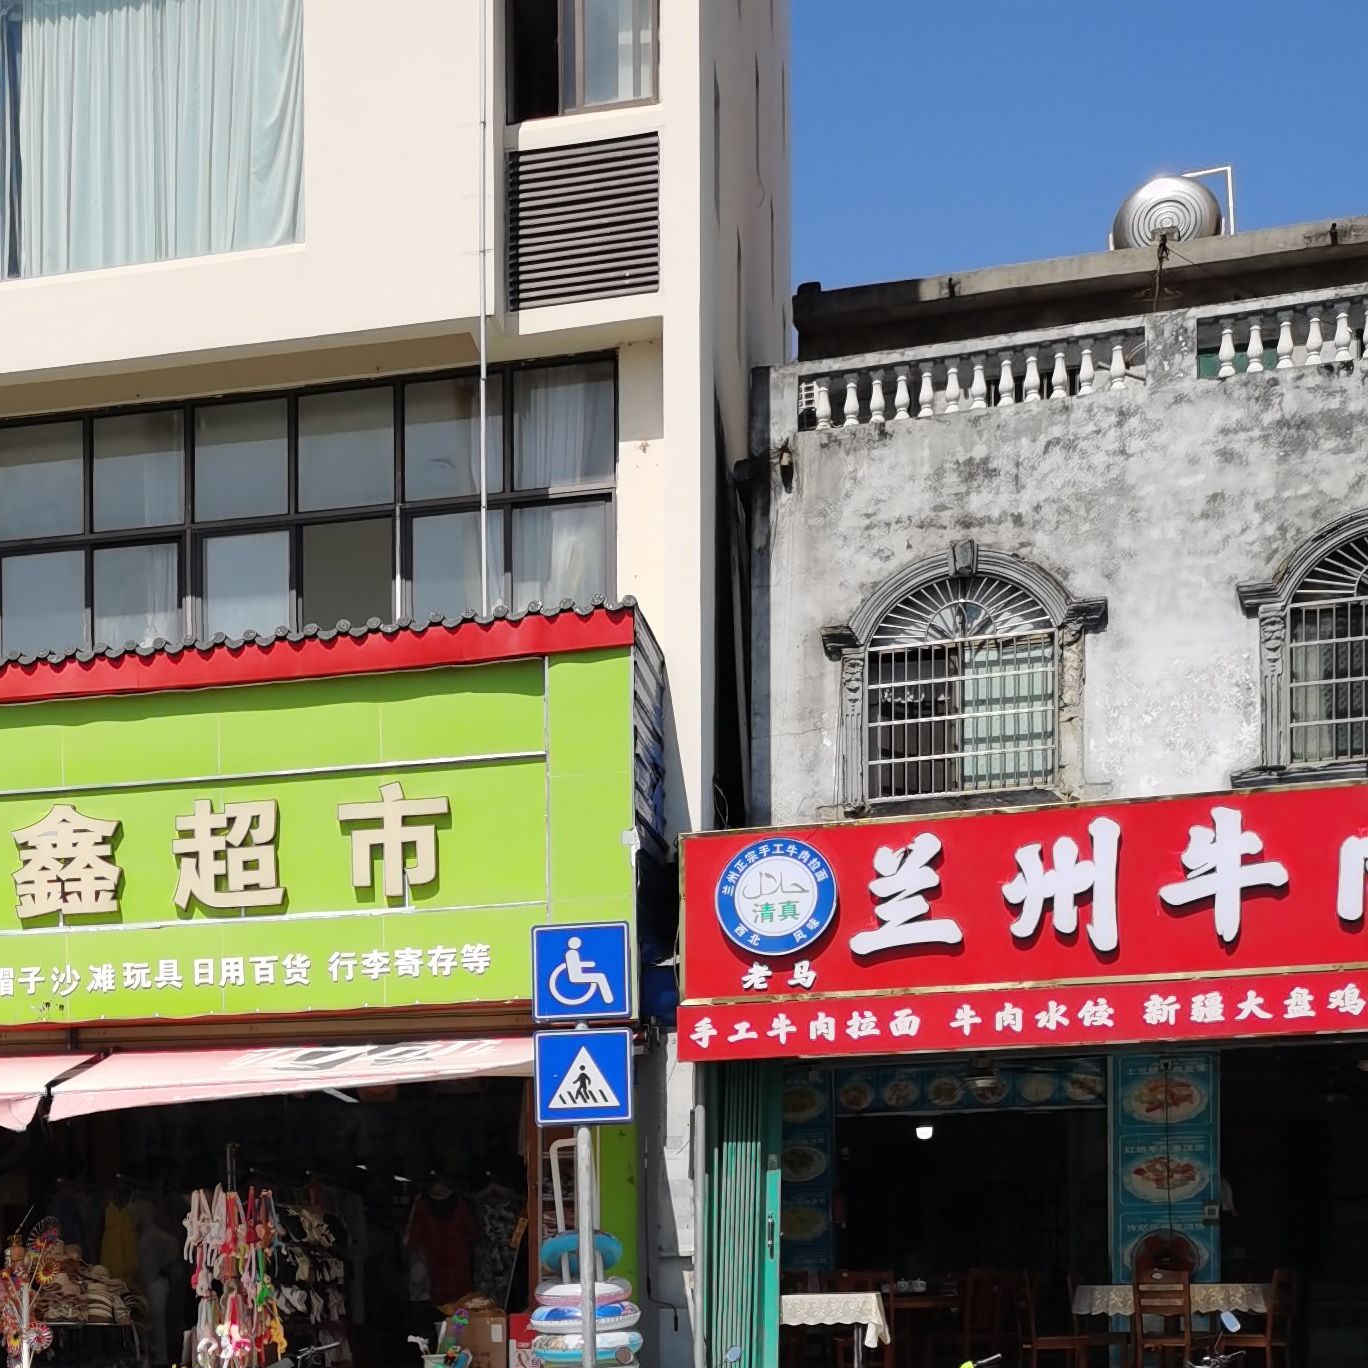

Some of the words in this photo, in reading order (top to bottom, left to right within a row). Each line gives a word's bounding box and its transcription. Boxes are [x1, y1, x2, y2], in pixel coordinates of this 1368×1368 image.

[722, 843, 829, 897] 兰州正宗手工牛肉拉面
[741, 871, 810, 900] حلال
[752, 900, 801, 924] 清真
[741, 959, 817, 990] 老马
[689, 1008, 921, 1049] 手工牛肉拉面
[949, 997, 1116, 1037] 牛肉水饺
[1142, 982, 1368, 1026] 新疆大盘鸡
